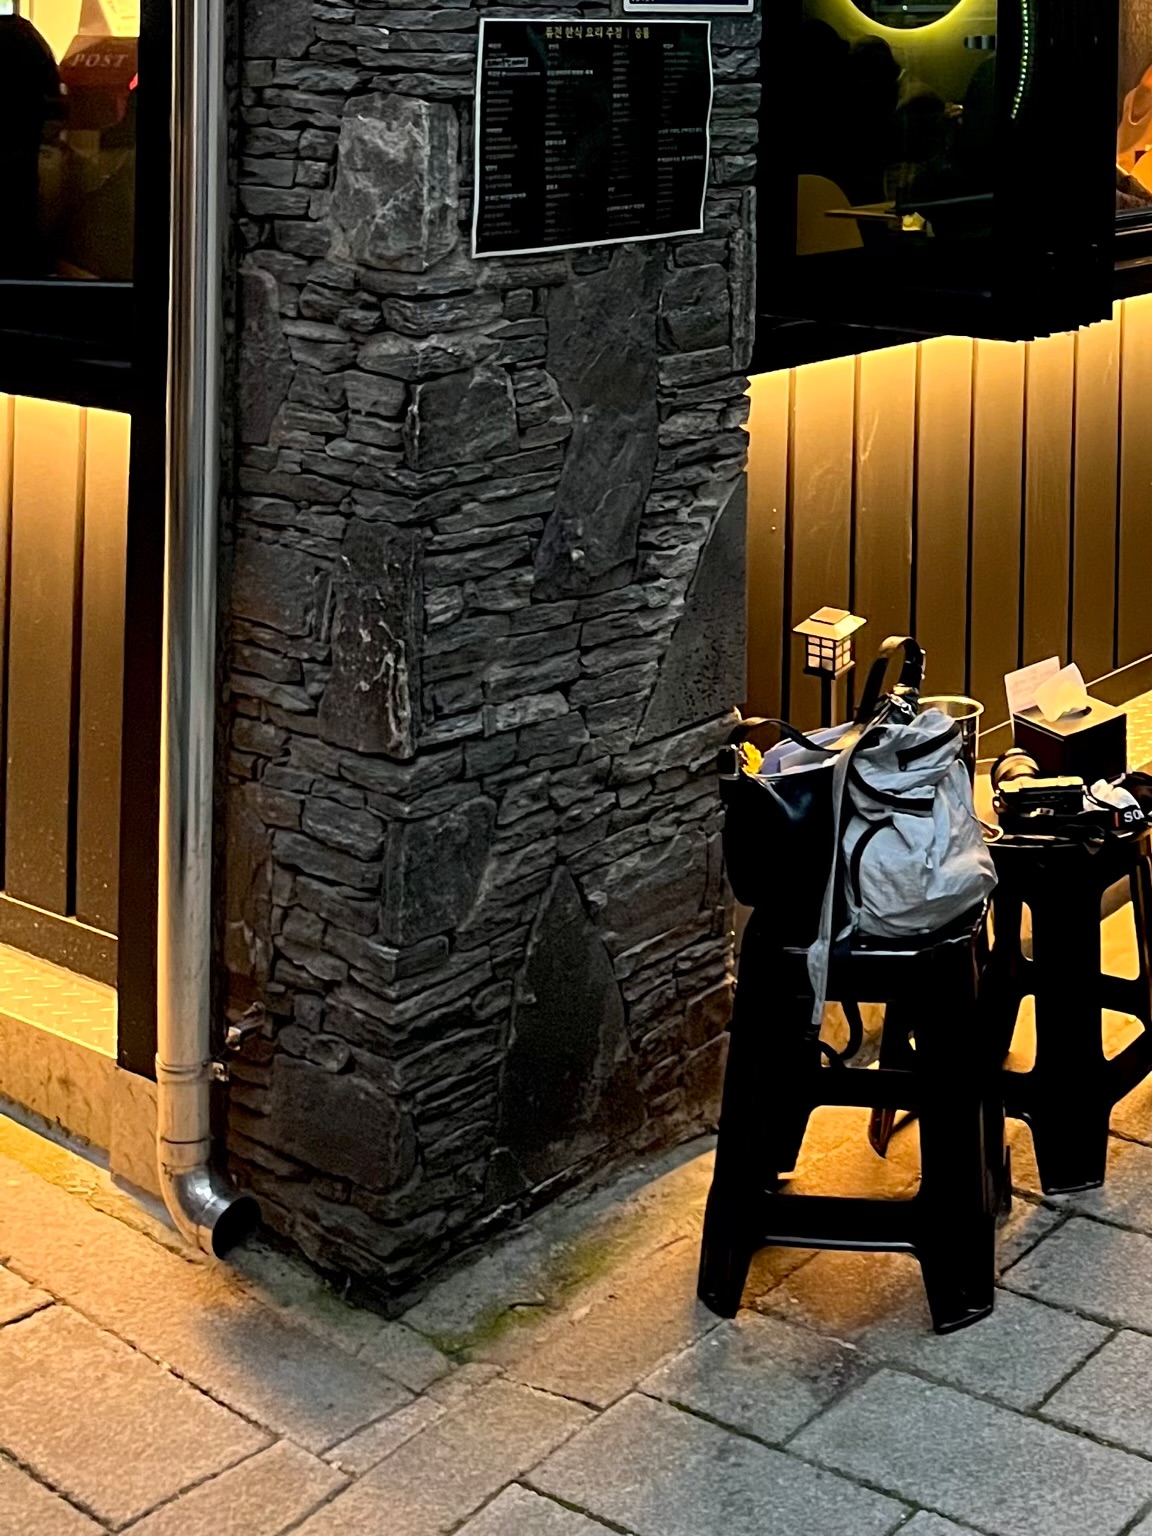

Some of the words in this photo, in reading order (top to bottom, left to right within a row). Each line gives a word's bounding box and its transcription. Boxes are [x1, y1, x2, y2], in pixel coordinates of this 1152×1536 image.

[565, 26, 582, 39] 한식
[585, 26, 603, 39] 요리
[606, 26, 622, 39] 주점
[71, 53, 128, 67] POST
